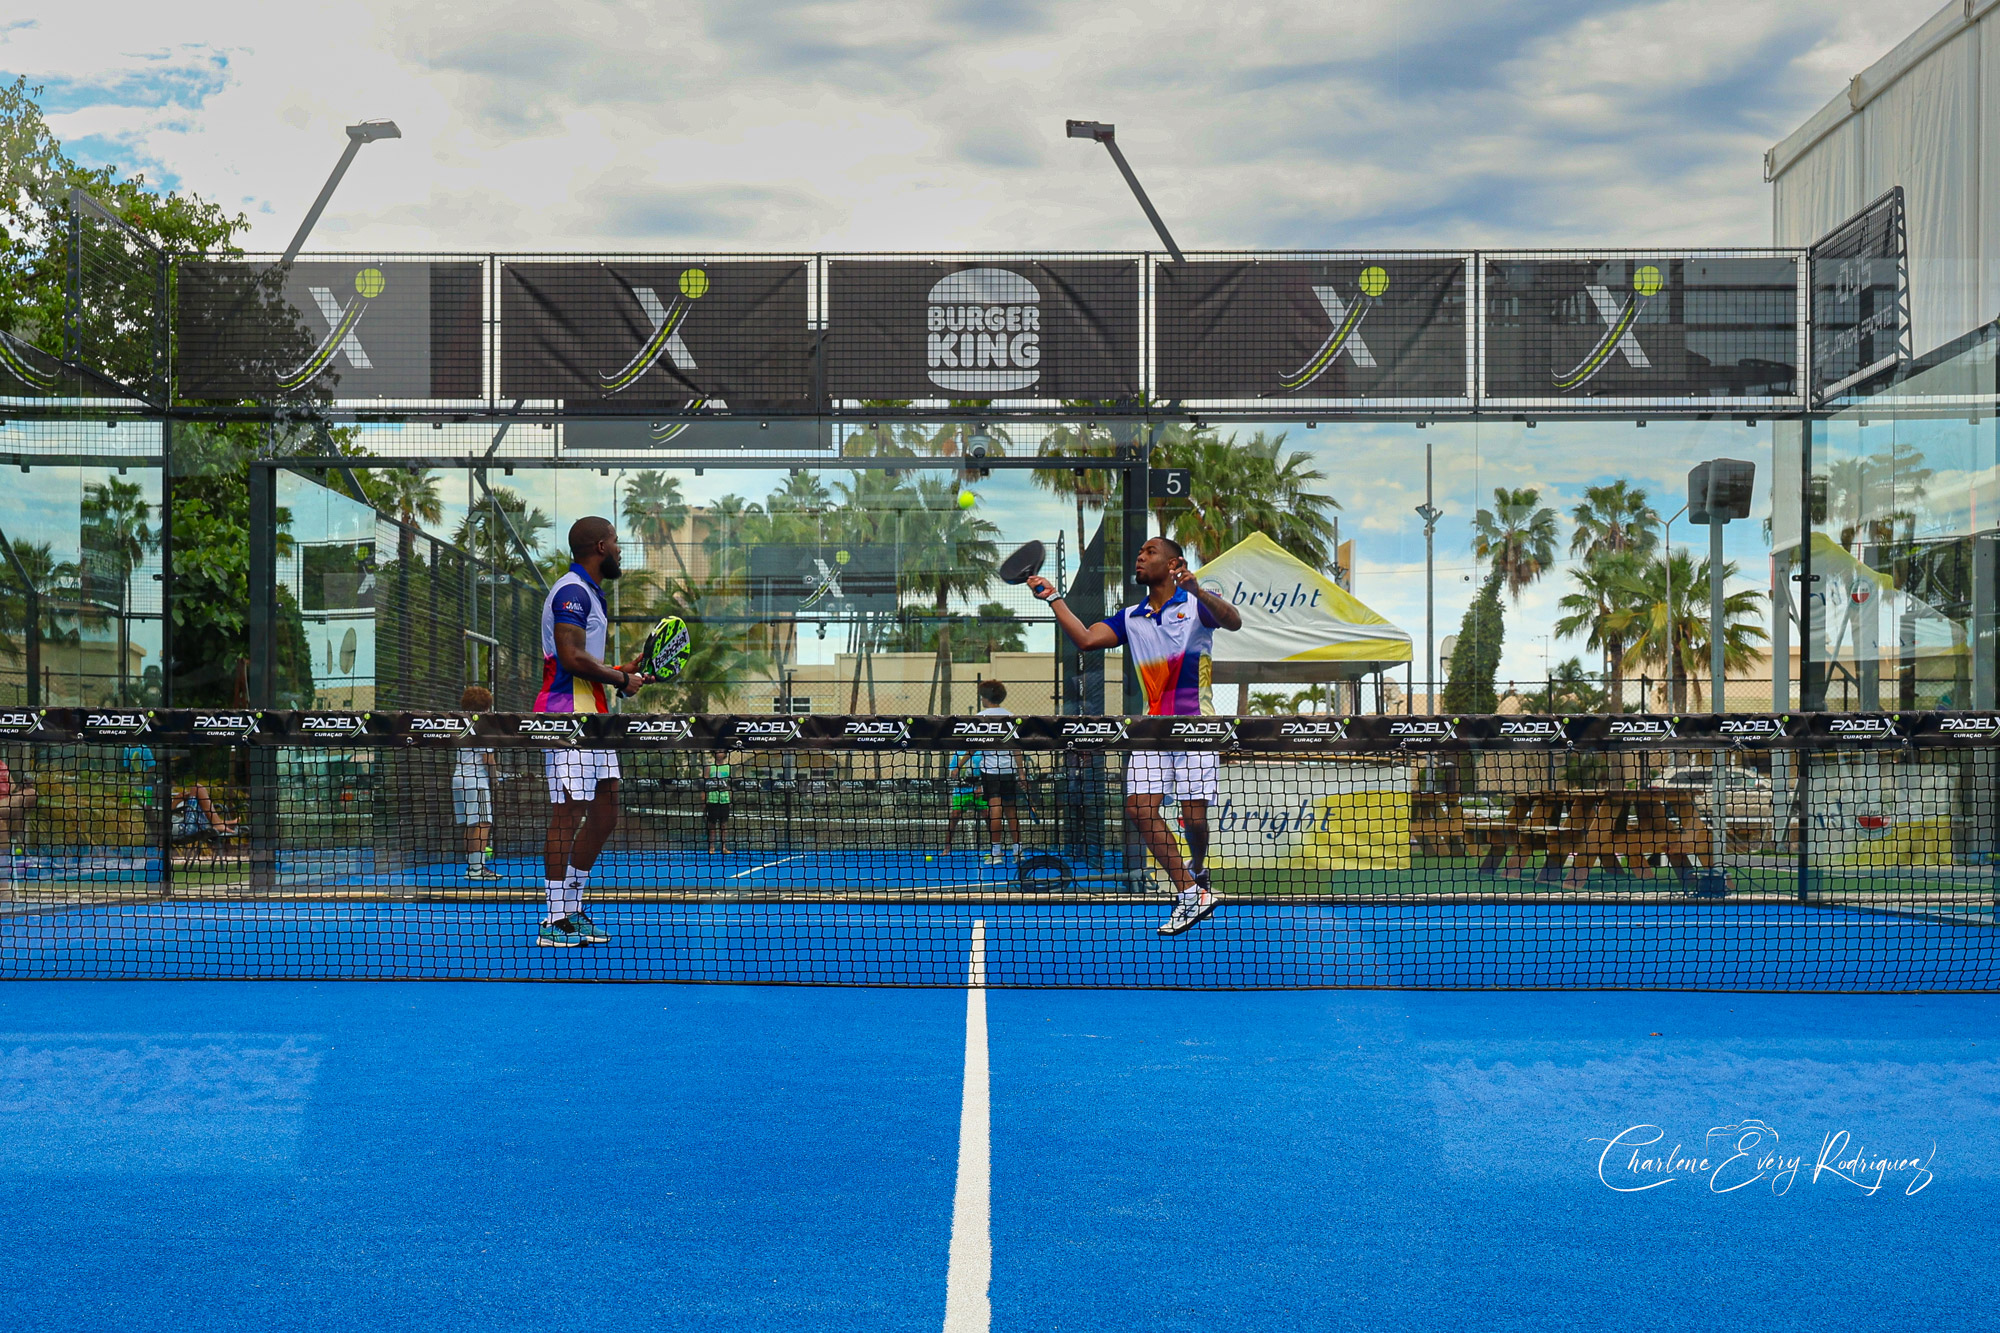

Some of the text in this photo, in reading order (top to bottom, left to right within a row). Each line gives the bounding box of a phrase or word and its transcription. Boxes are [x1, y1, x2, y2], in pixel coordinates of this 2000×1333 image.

[928, 306, 1040, 331] BURGER
[928, 332, 1040, 368] KING
[1166, 473, 1181, 494] 5
[1232, 578, 1322, 613] bright
[0, 713, 44, 734] DELX
[1218, 797, 1336, 839] bright
